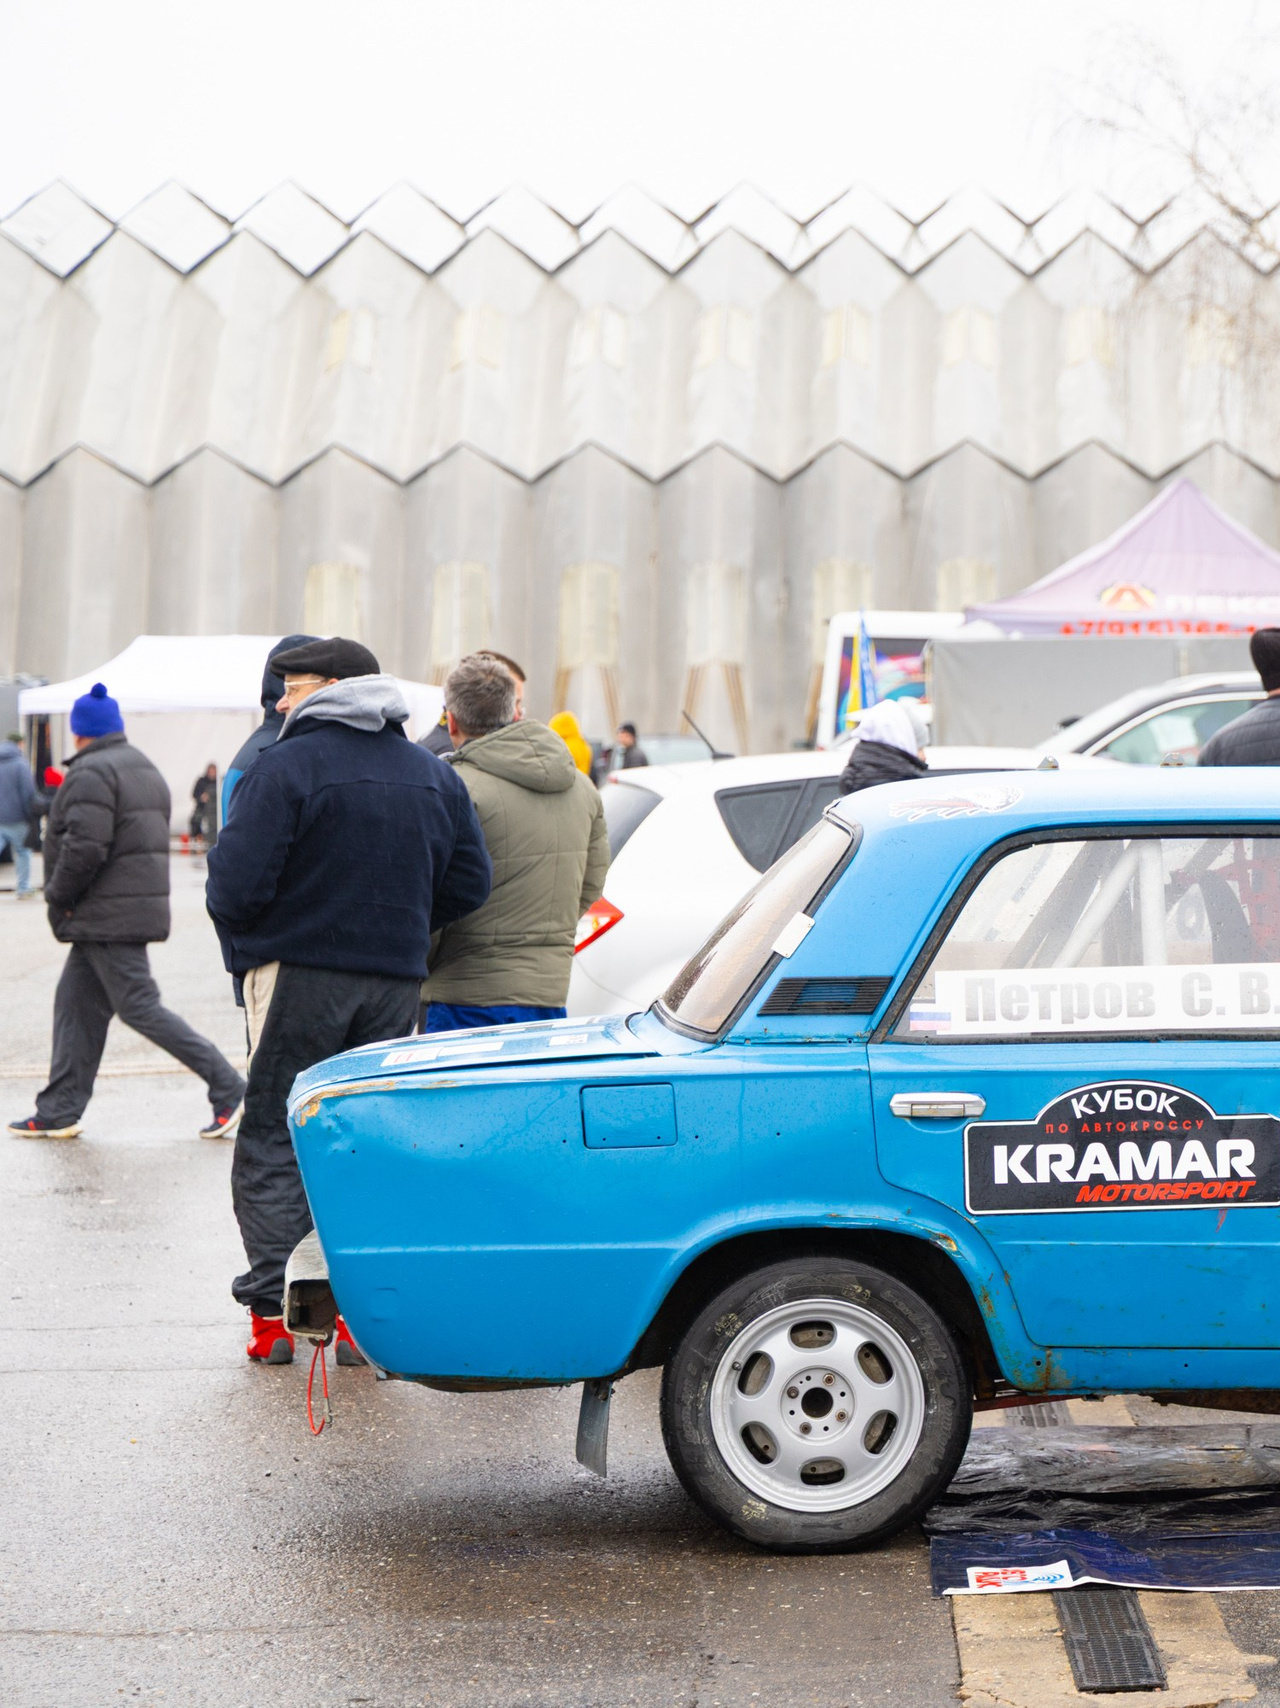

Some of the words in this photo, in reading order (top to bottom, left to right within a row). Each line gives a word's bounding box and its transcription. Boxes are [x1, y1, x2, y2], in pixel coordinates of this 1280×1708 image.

[964, 977, 1156, 1025] Петров
[1181, 971, 1226, 1018] С.
[1071, 1088, 1180, 1119] КУБОК
[1045, 1122, 1070, 1135] ПО
[1081, 1119, 1205, 1134] АВТОКРОССУ
[993, 1138, 1257, 1185] KRAMAR
[1075, 1180, 1257, 1203] MOTORSPORT
